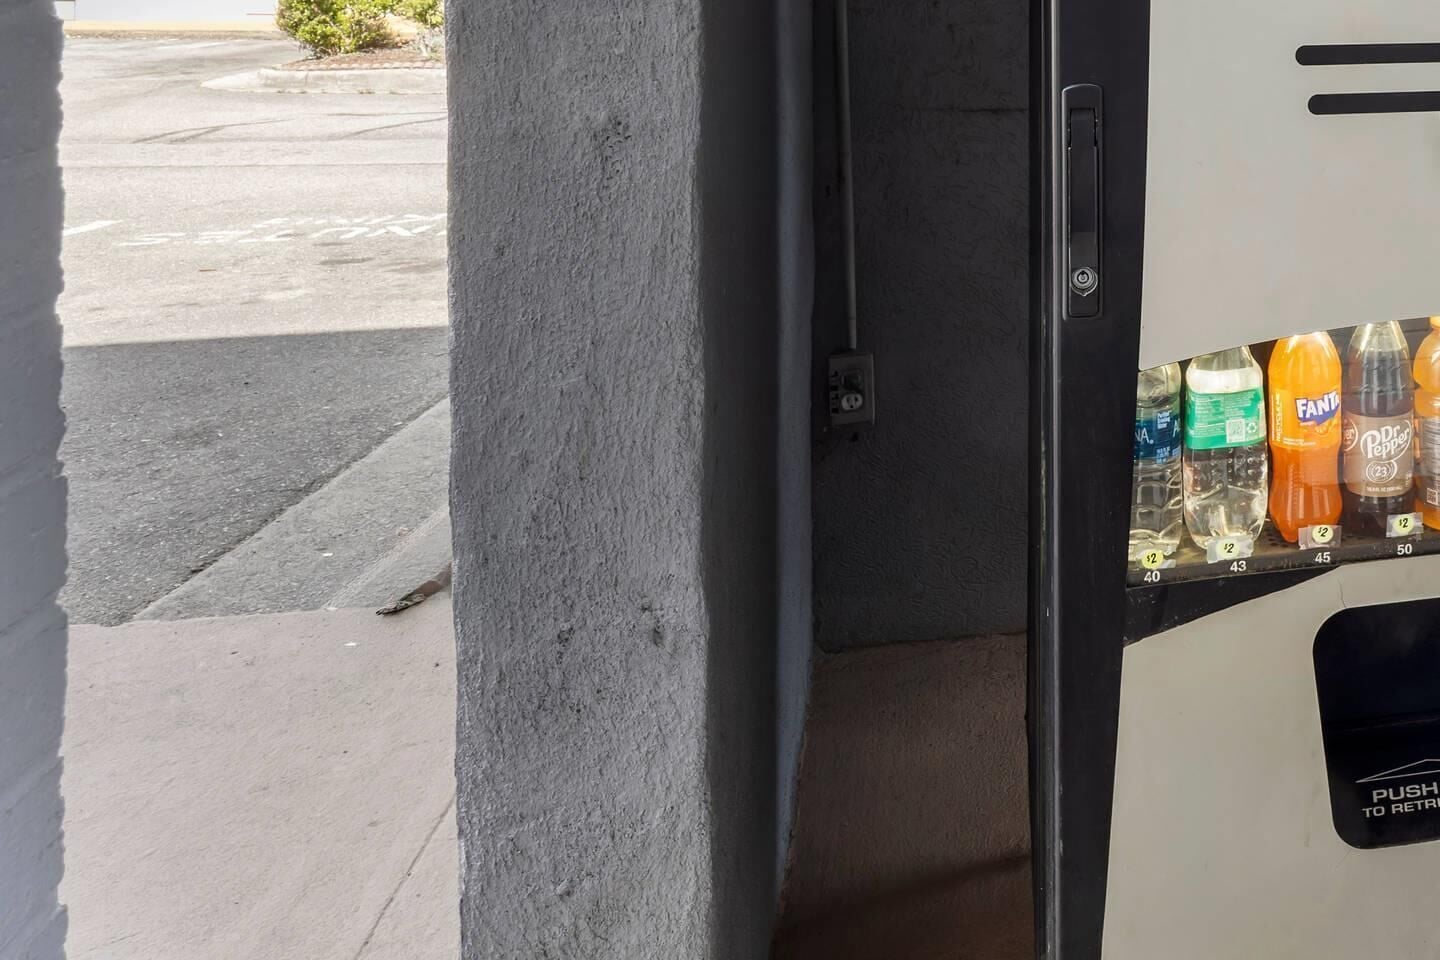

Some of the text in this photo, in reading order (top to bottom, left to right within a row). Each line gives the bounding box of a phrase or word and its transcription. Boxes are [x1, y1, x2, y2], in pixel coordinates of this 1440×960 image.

[1380, 425, 1400, 442] Dr
[1361, 427, 1410, 459] Pepper
[1375, 465, 1387, 477] 23
[1399, 518, 1409, 528] $2
[1318, 527, 1328, 537] $2
[1224, 543, 1235, 553] $2
[1397, 544, 1413, 555] 50
[1146, 553, 1157, 564] $2
[1315, 552, 1331, 563] 45
[1230, 561, 1247, 572] 43
[1144, 571, 1161, 583] 40
[1372, 782, 1438, 803] PUSH
[1362, 805, 1386, 818] TO
